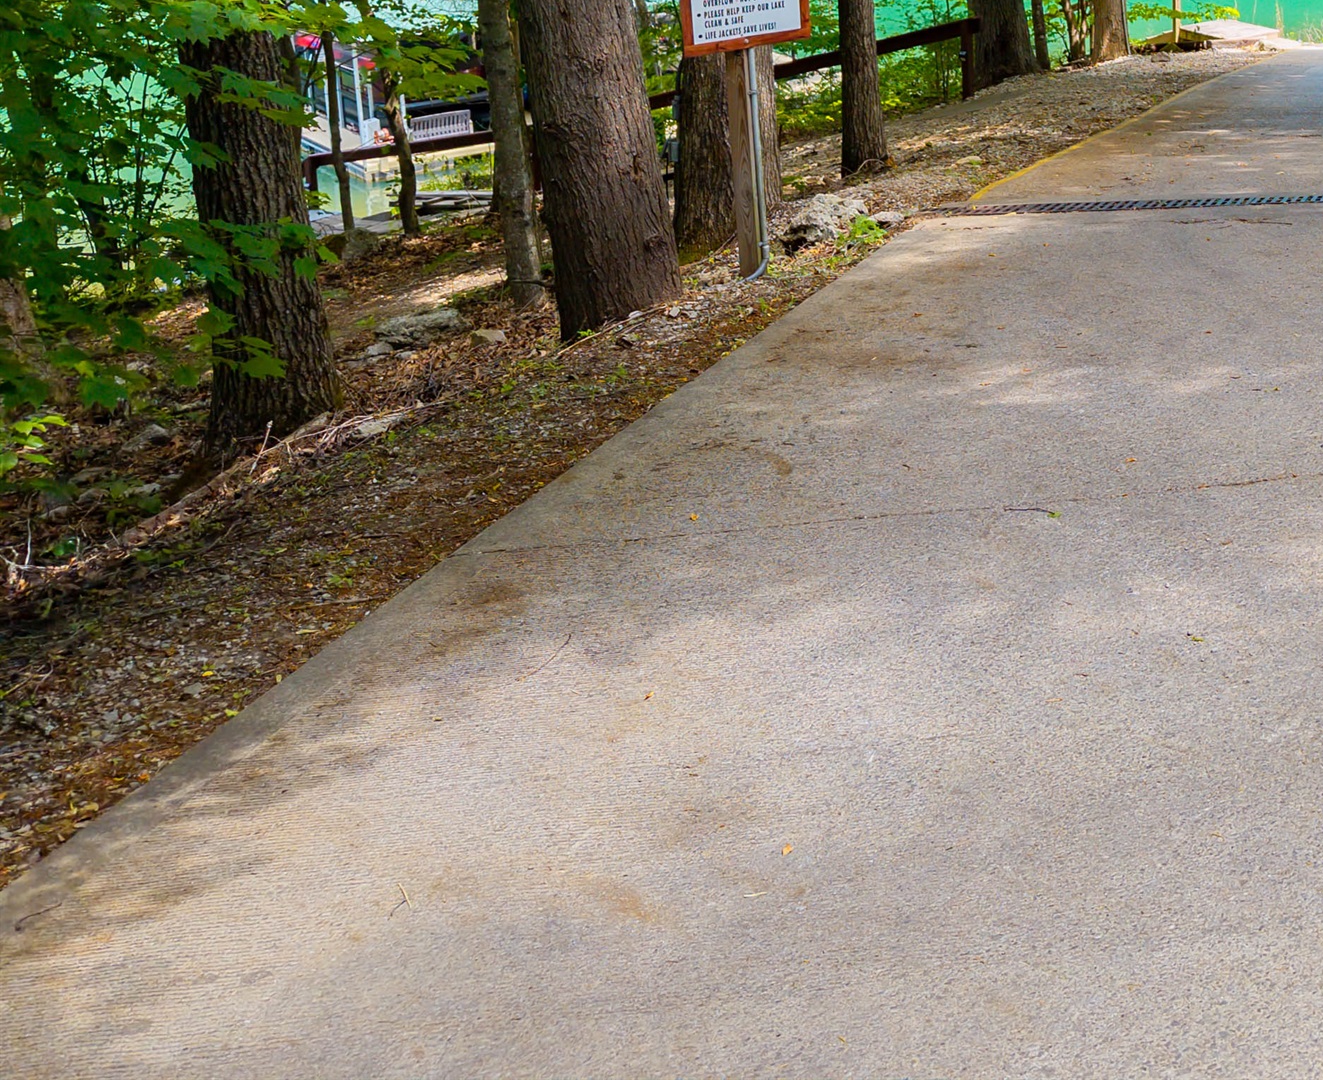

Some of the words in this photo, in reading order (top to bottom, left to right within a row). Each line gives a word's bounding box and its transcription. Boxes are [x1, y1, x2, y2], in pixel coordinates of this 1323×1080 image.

[703, 9, 724, 19] PLEASE
[726, 6, 740, 16] HELP
[741, 5, 756, 14] KEEP
[757, 3, 769, 11] OUR
[771, 0, 785, 10] LAKE
[704, 19, 723, 29] CLEAN
[724, 18, 729, 26] &
[731, 15, 744, 25] SAFE
[704, 31, 717, 40] LIFE
[718, 27, 742, 38] JACKETS
[743, 24, 757, 34] SAVE
[759, 22, 777, 32] LIVES!
